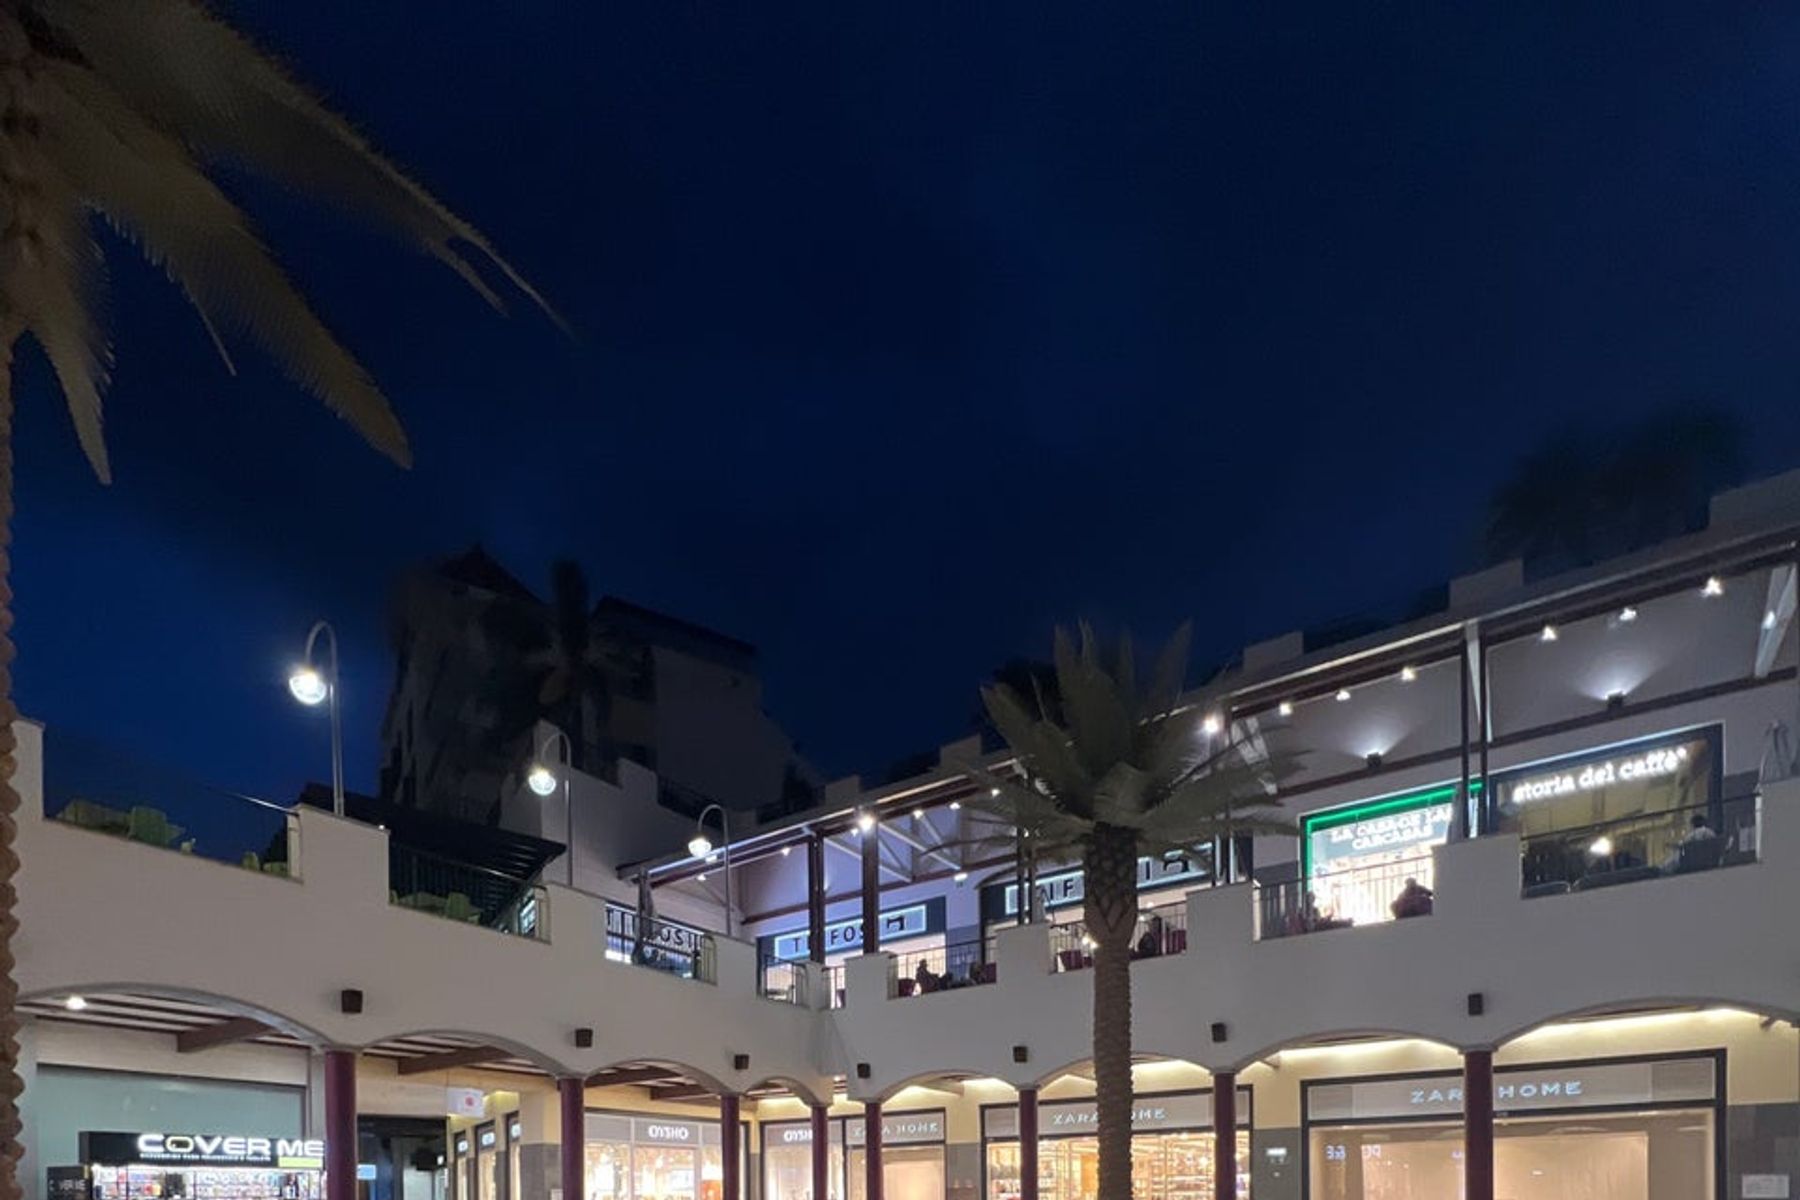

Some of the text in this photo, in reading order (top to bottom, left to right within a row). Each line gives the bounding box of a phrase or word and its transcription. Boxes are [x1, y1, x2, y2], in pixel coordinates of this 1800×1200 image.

[1512, 775, 1575, 803] storia
[1579, 763, 1616, 788] del
[1411, 1081, 1583, 1104] ZAR HOME
[137, 1133, 271, 1156] COVER
[276, 1139, 325, 1157] ME
